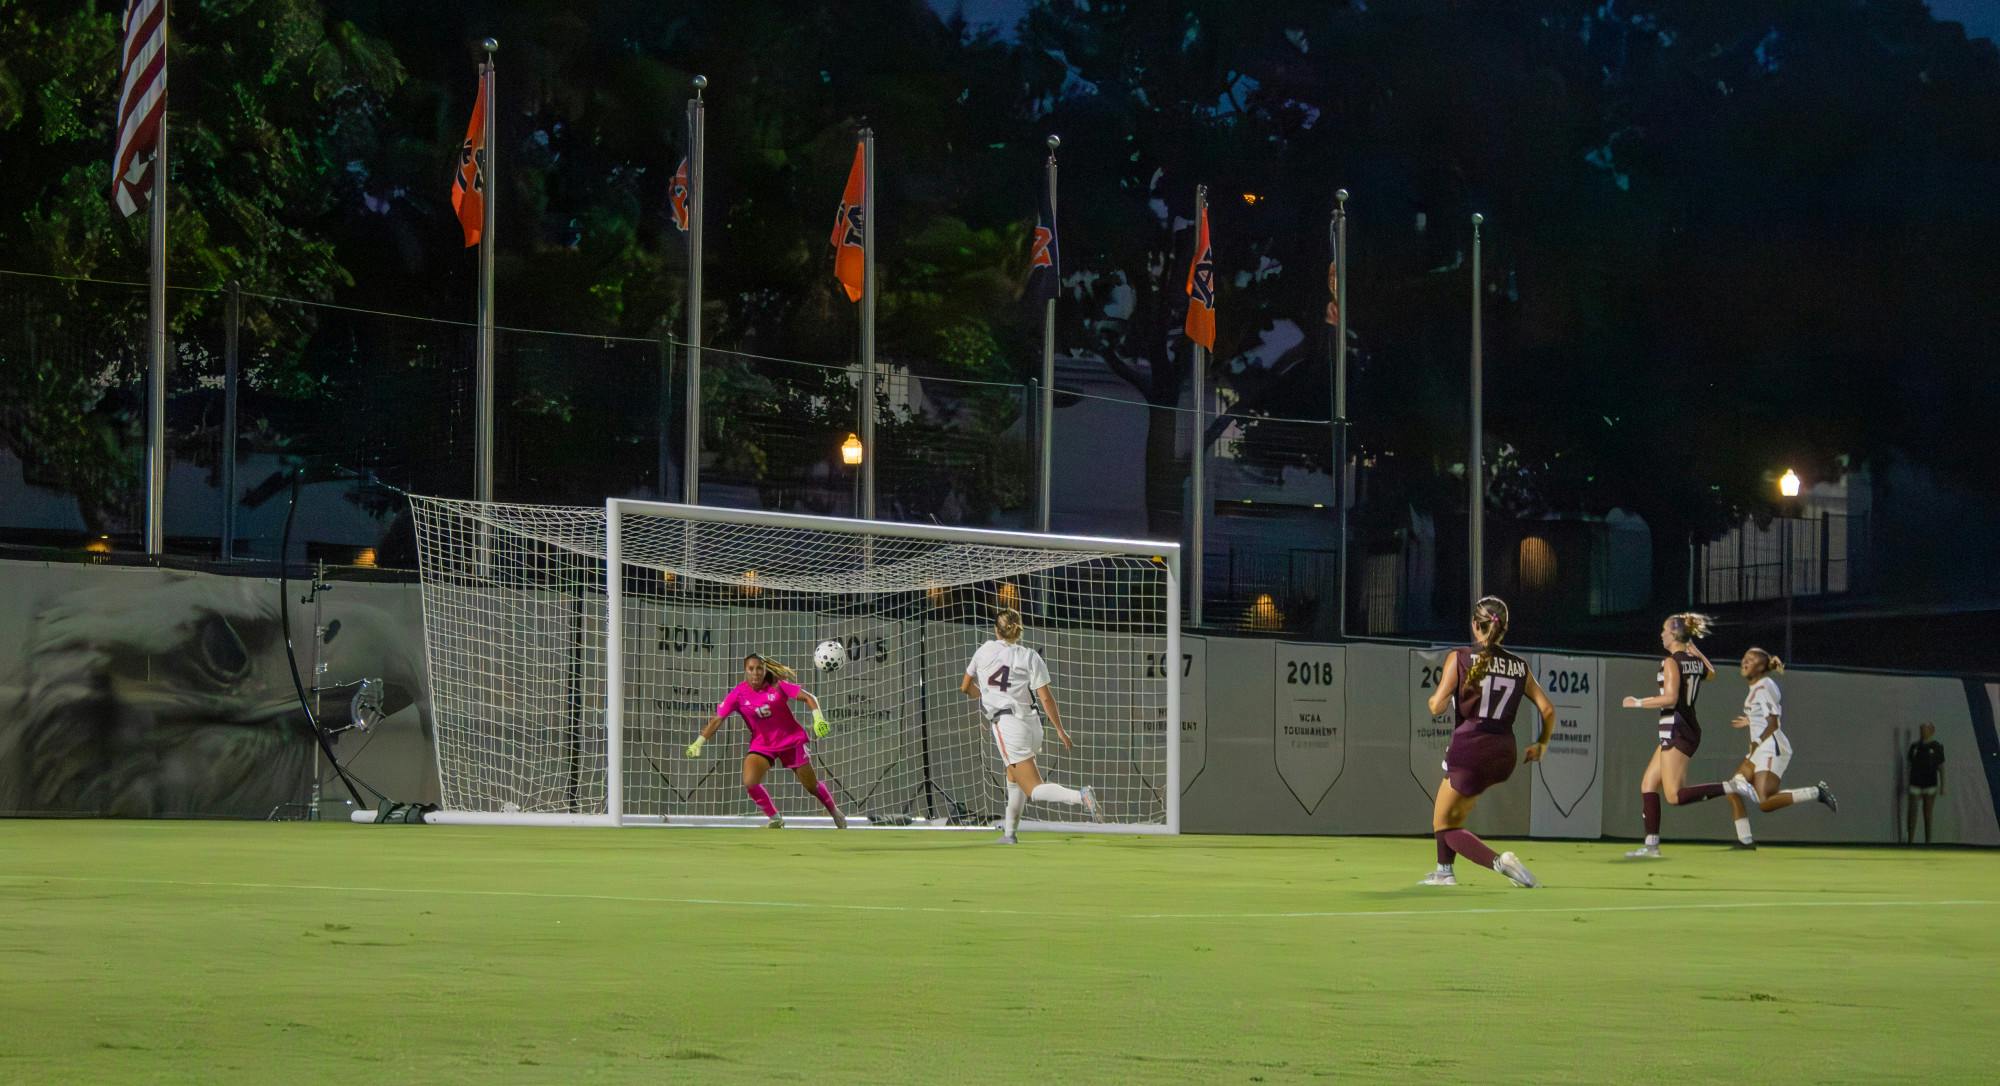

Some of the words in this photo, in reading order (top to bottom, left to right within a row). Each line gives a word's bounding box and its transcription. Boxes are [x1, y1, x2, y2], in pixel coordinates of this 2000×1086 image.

[658, 625, 714, 652] 2014
[832, 636, 888, 663] 015
[1146, 653, 1193, 678] 207
[1287, 661, 1333, 685] 2018
[988, 665, 1011, 692] 4
[1548, 670, 1590, 694] 2024
[1479, 674, 1516, 720] 17
[755, 704, 772, 718] 15
[1299, 713, 1322, 723] NCAA
[1284, 726, 1338, 736] TOURNAMENT
